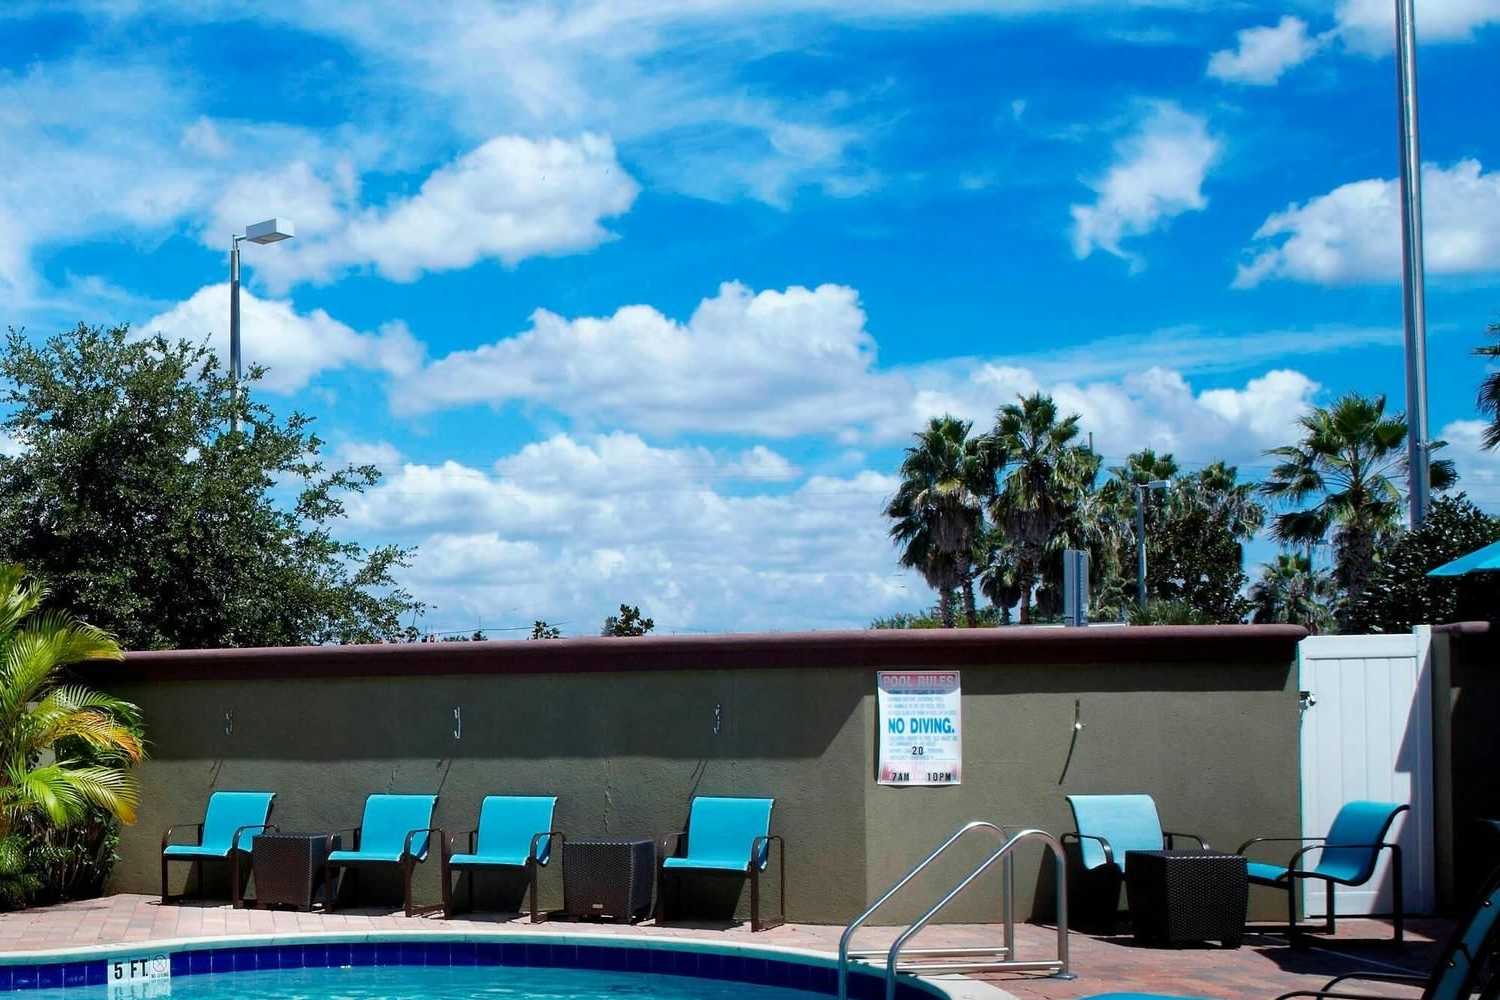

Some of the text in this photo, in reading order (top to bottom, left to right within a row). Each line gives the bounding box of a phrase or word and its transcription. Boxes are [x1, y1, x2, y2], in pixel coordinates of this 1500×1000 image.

[883, 675, 954, 688] POOL RULES
[888, 718, 955, 734] NO DIVING.
[911, 746, 924, 756] 20
[892, 772, 951, 782] 7AM 10PM
[114, 958, 149, 980] 5 FT.
